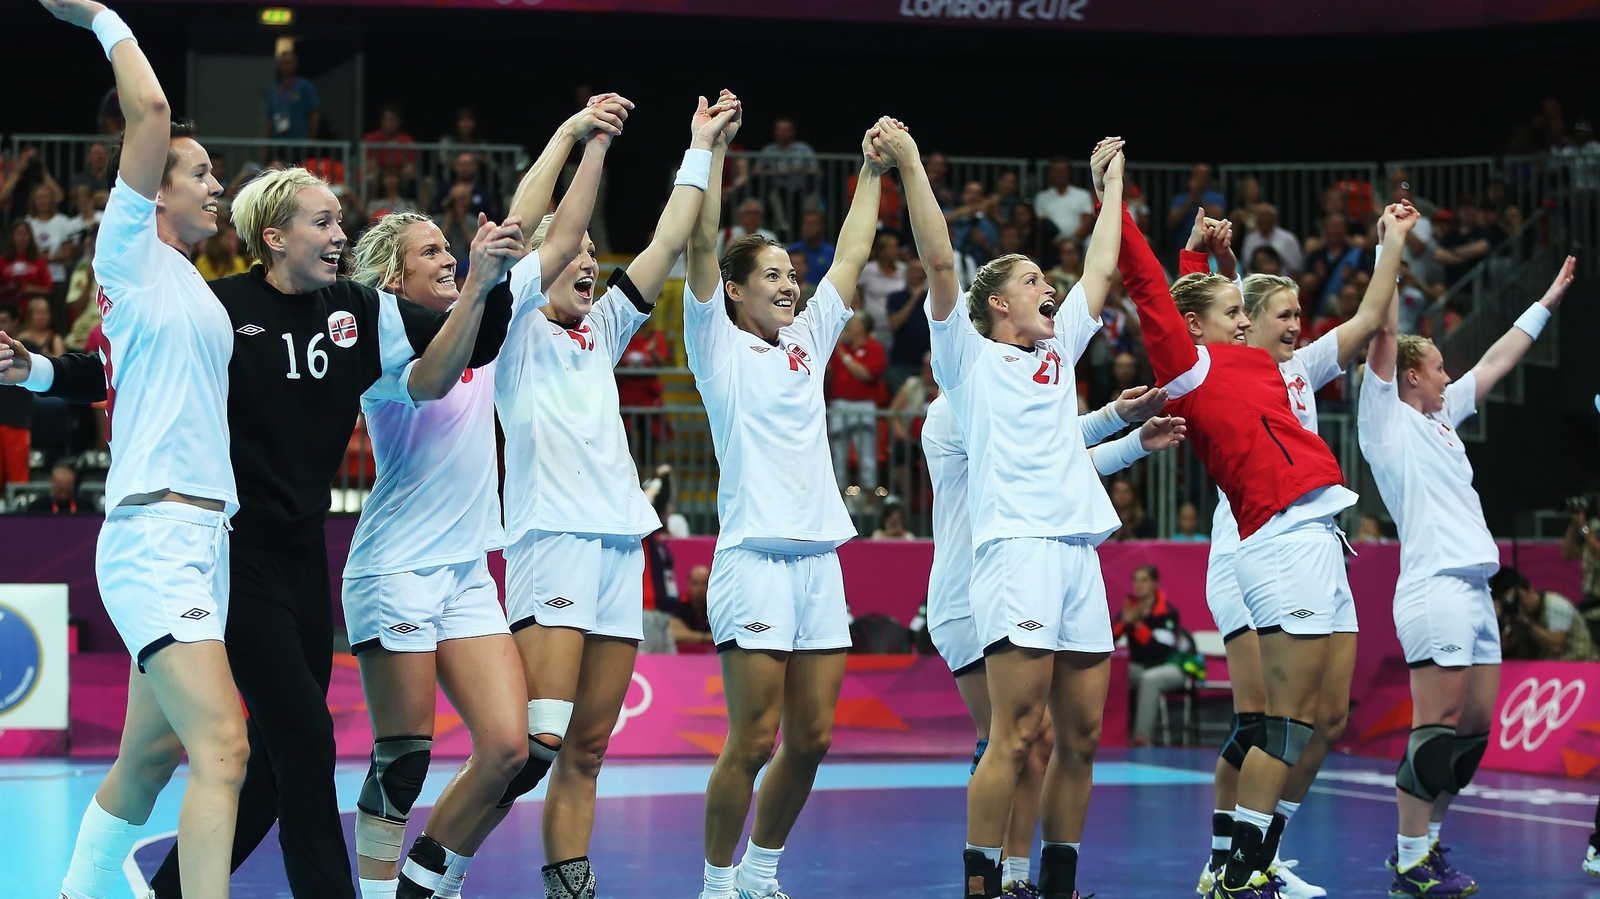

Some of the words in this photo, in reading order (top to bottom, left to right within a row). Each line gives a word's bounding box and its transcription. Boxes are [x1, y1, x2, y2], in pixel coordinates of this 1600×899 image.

[900, 0, 1012, 19] London
[1018, 0, 1088, 21] 2012
[281, 332, 329, 379] 16
